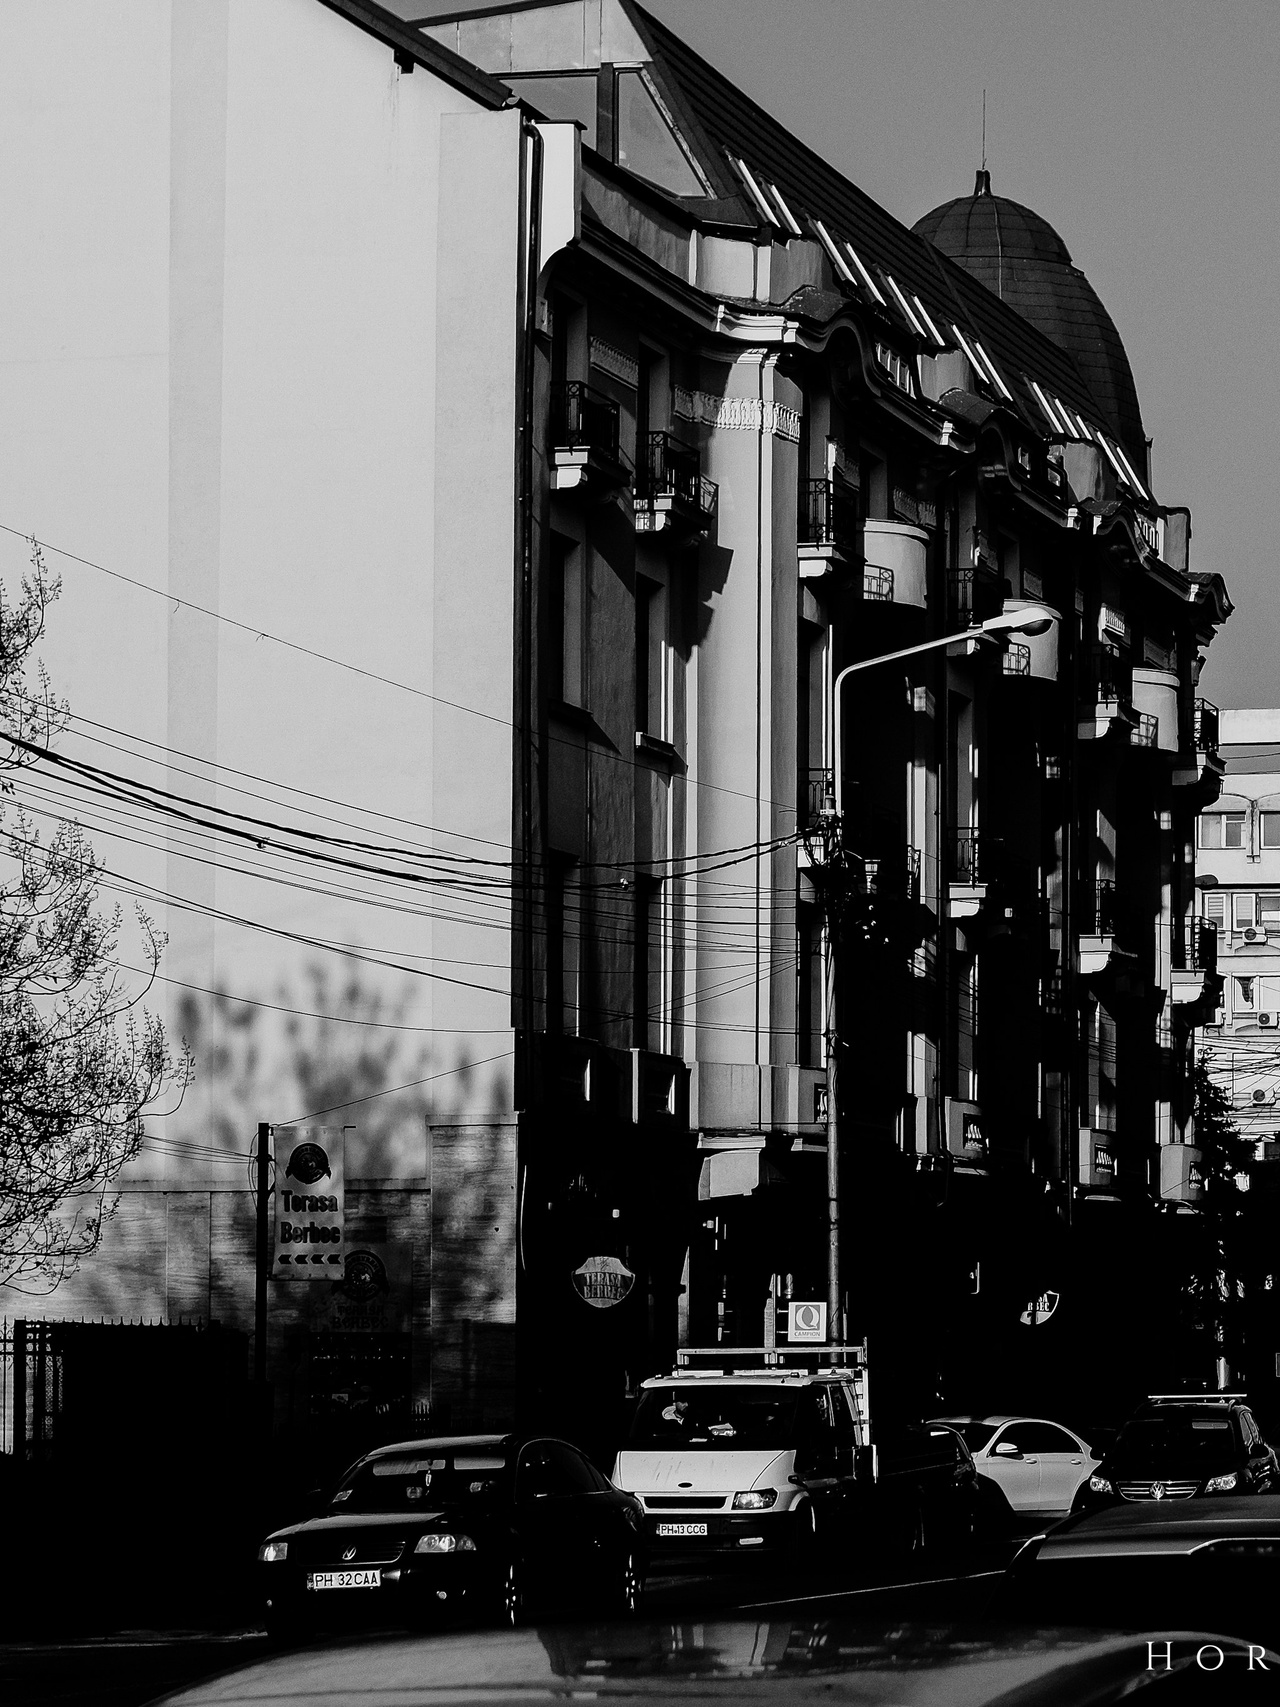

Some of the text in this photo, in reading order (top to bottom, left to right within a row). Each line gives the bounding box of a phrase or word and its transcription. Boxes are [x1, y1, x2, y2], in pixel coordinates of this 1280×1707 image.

[281, 1190, 338, 1212] Terasa
[280, 1221, 341, 1244] Berbec
[661, 1525, 674, 1535] PH
[315, 1574, 333, 1587] PH
